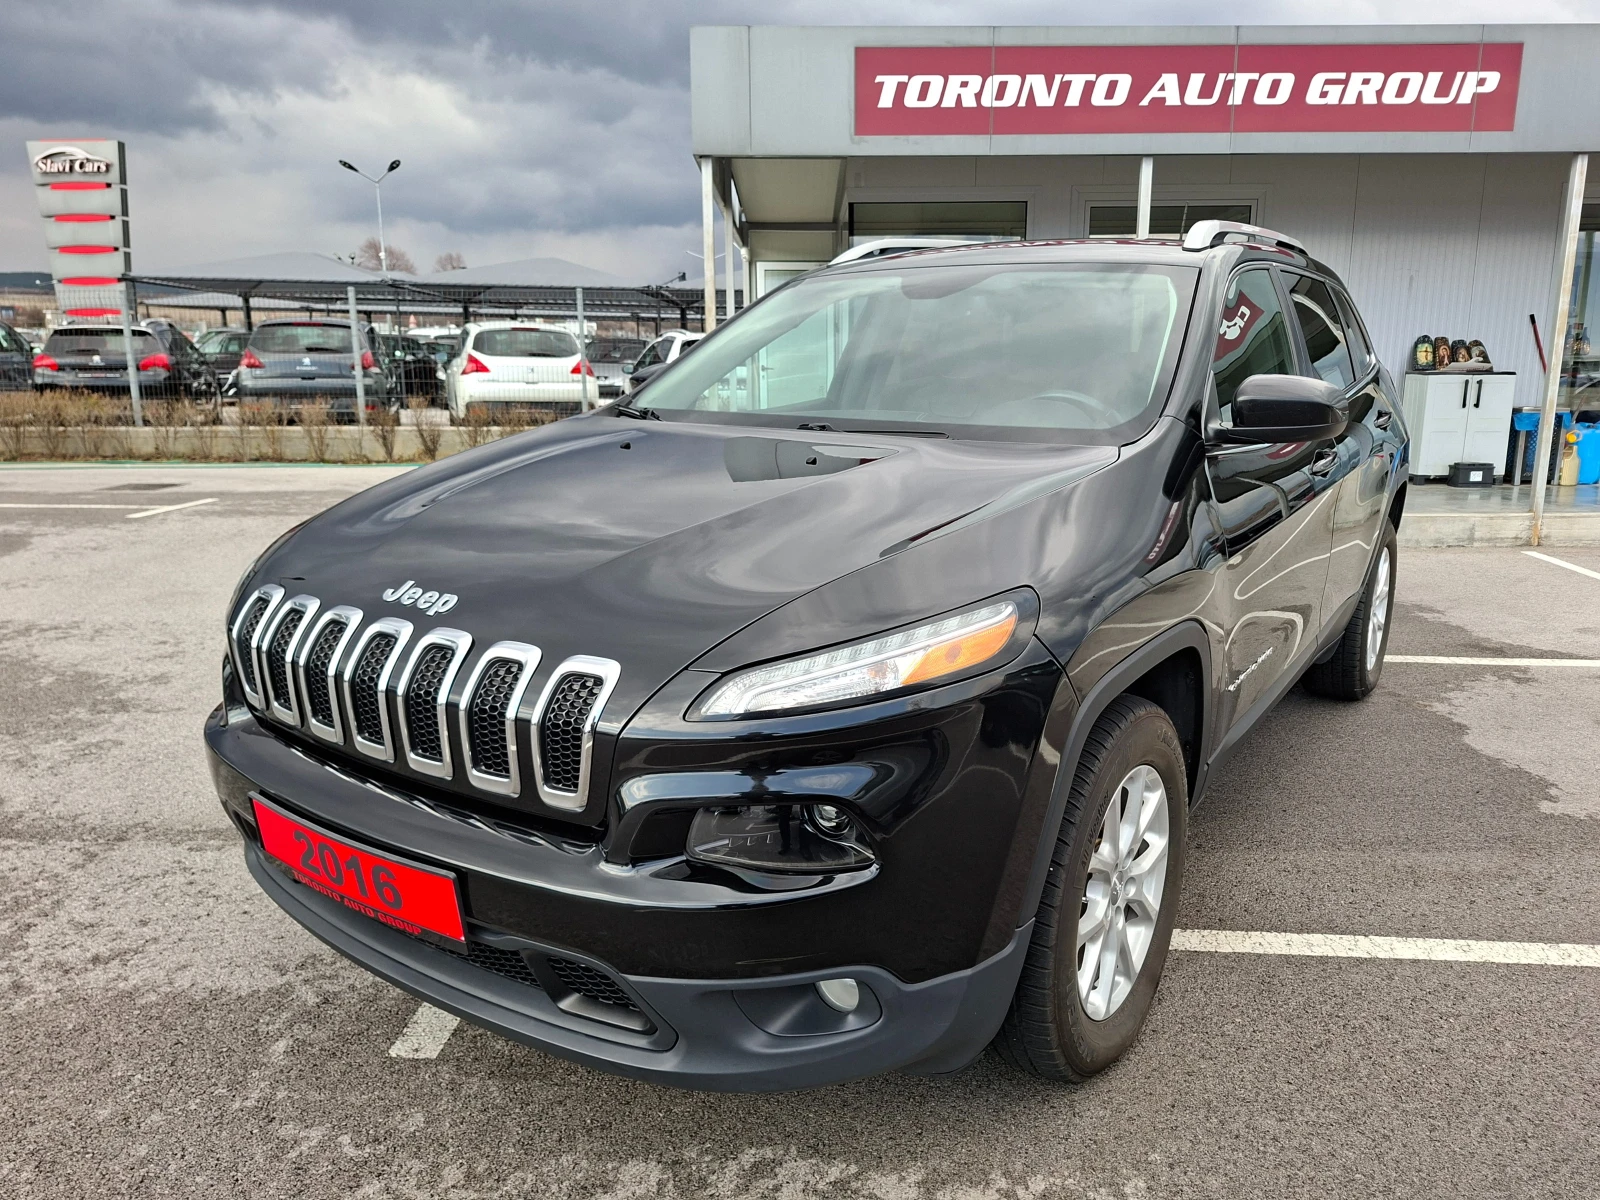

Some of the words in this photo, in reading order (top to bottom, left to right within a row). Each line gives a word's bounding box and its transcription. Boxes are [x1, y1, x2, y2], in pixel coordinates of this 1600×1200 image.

[874, 73, 1132, 109] TORONTO
[1138, 72, 1296, 107] AUTO
[1305, 70, 1501, 106] GROUP
[37, 159, 71, 173] Slavi
[74, 159, 107, 173] Cars
[382, 580, 459, 616] Jeep
[293, 829, 404, 911] 2016
[291, 869, 341, 902] TORONTO
[343, 897, 375, 918] AUTO
[377, 911, 422, 936] GROUP
